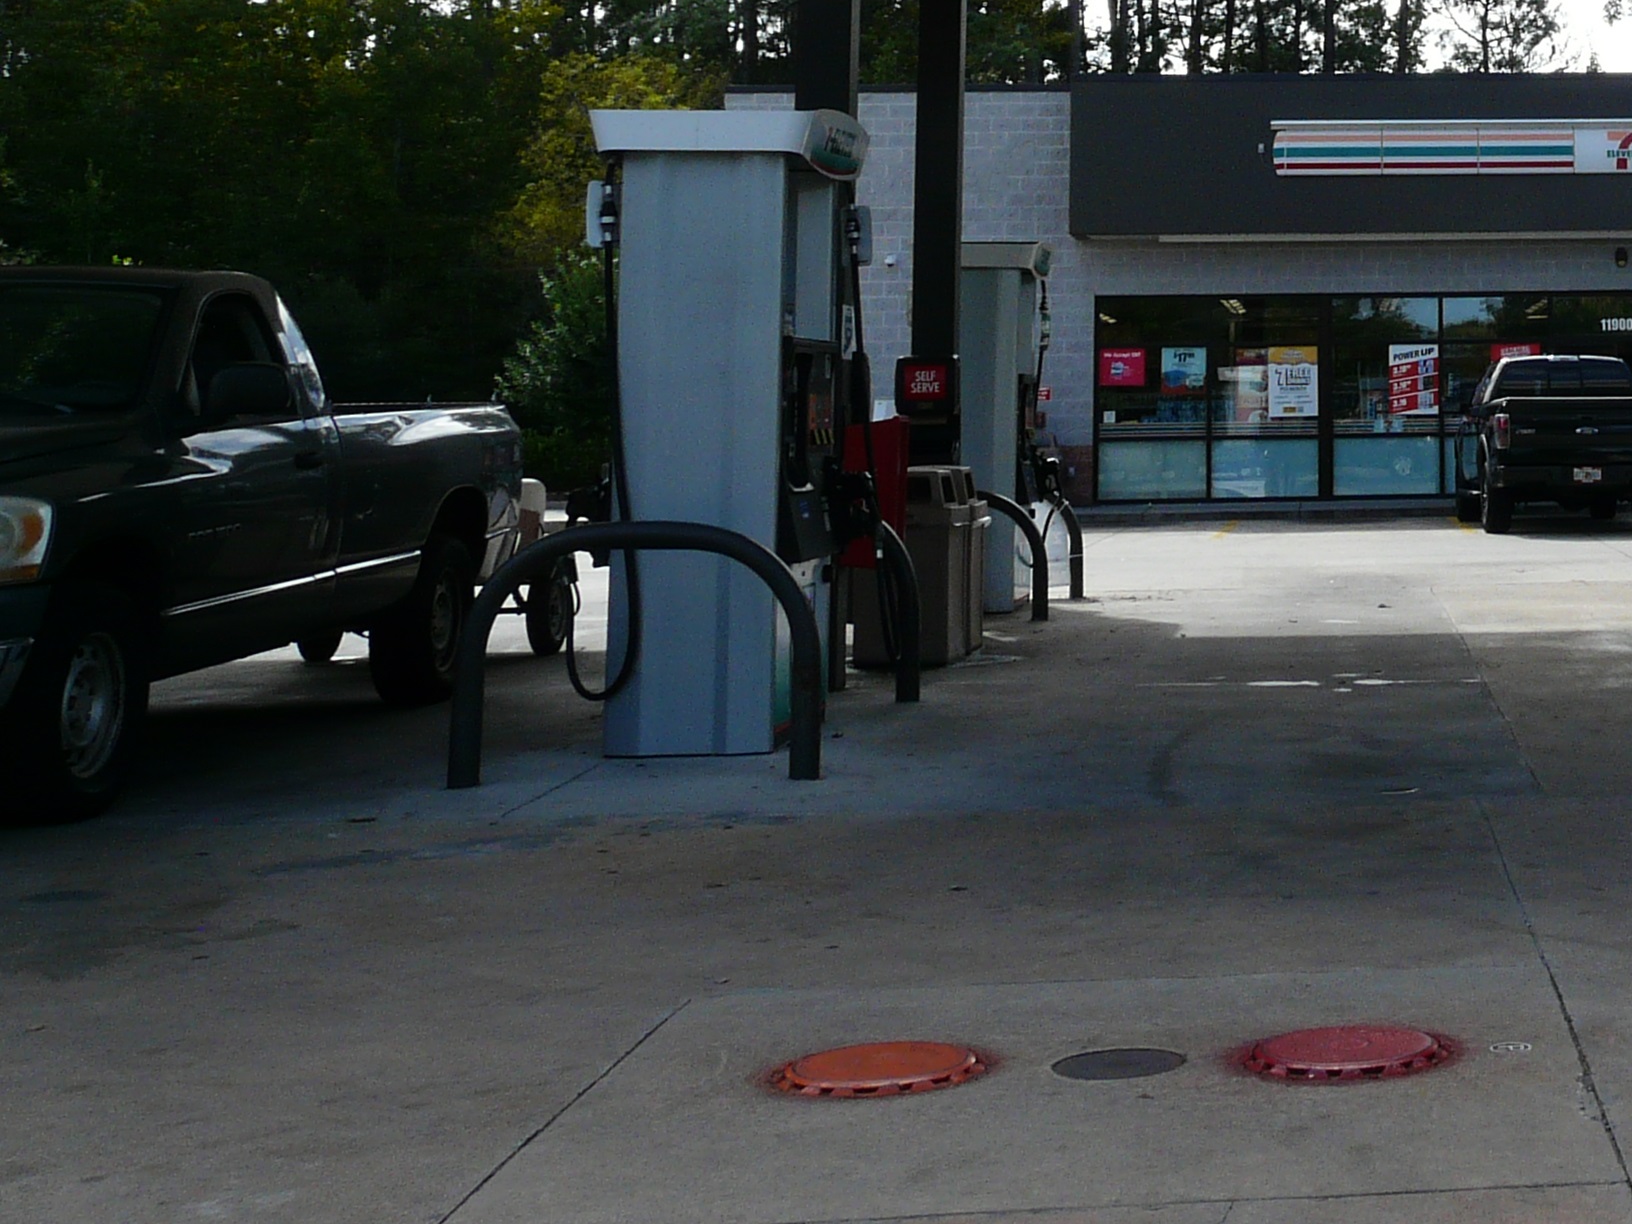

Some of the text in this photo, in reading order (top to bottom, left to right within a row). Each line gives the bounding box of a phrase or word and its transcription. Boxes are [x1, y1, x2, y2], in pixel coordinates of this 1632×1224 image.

[1393, 347, 1434, 361] POWER UP
[915, 370, 936, 382] SELF
[910, 382, 940, 393] SERVE
